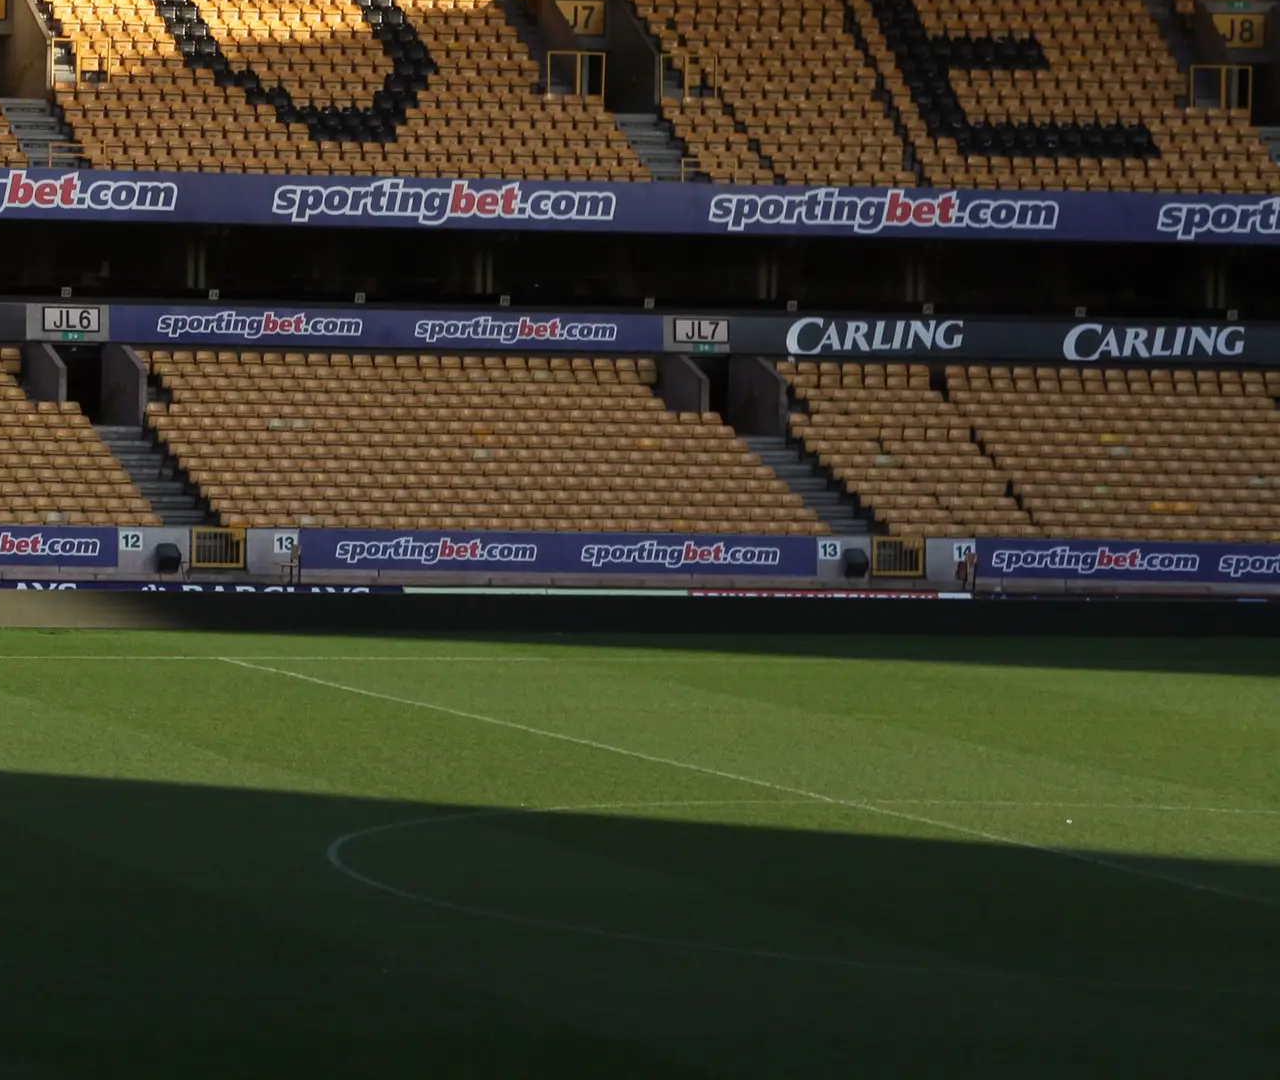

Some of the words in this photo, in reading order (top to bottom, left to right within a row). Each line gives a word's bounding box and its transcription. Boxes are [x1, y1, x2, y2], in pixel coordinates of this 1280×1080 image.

[570, 5, 595, 30] J7
[1223, 19, 1254, 43] J8
[272, 179, 616, 224] sportingbet.com
[709, 188, 1059, 234] sportingbet.com
[52, 310, 92, 330] JL6
[157, 311, 362, 339] sportingbet.com
[415, 316, 617, 344] sportingbet.com
[685, 322, 719, 340] JL7
[786, 317, 964, 355] CARLING
[1063, 323, 1245, 361] CARLING
[122, 534, 141, 548] 12
[336, 536, 537, 564] sportingbet.com
[581, 540, 779, 567] sportingbet.com
[820, 543, 838, 557] 13
[992, 546, 1199, 573] sportingbet.com
